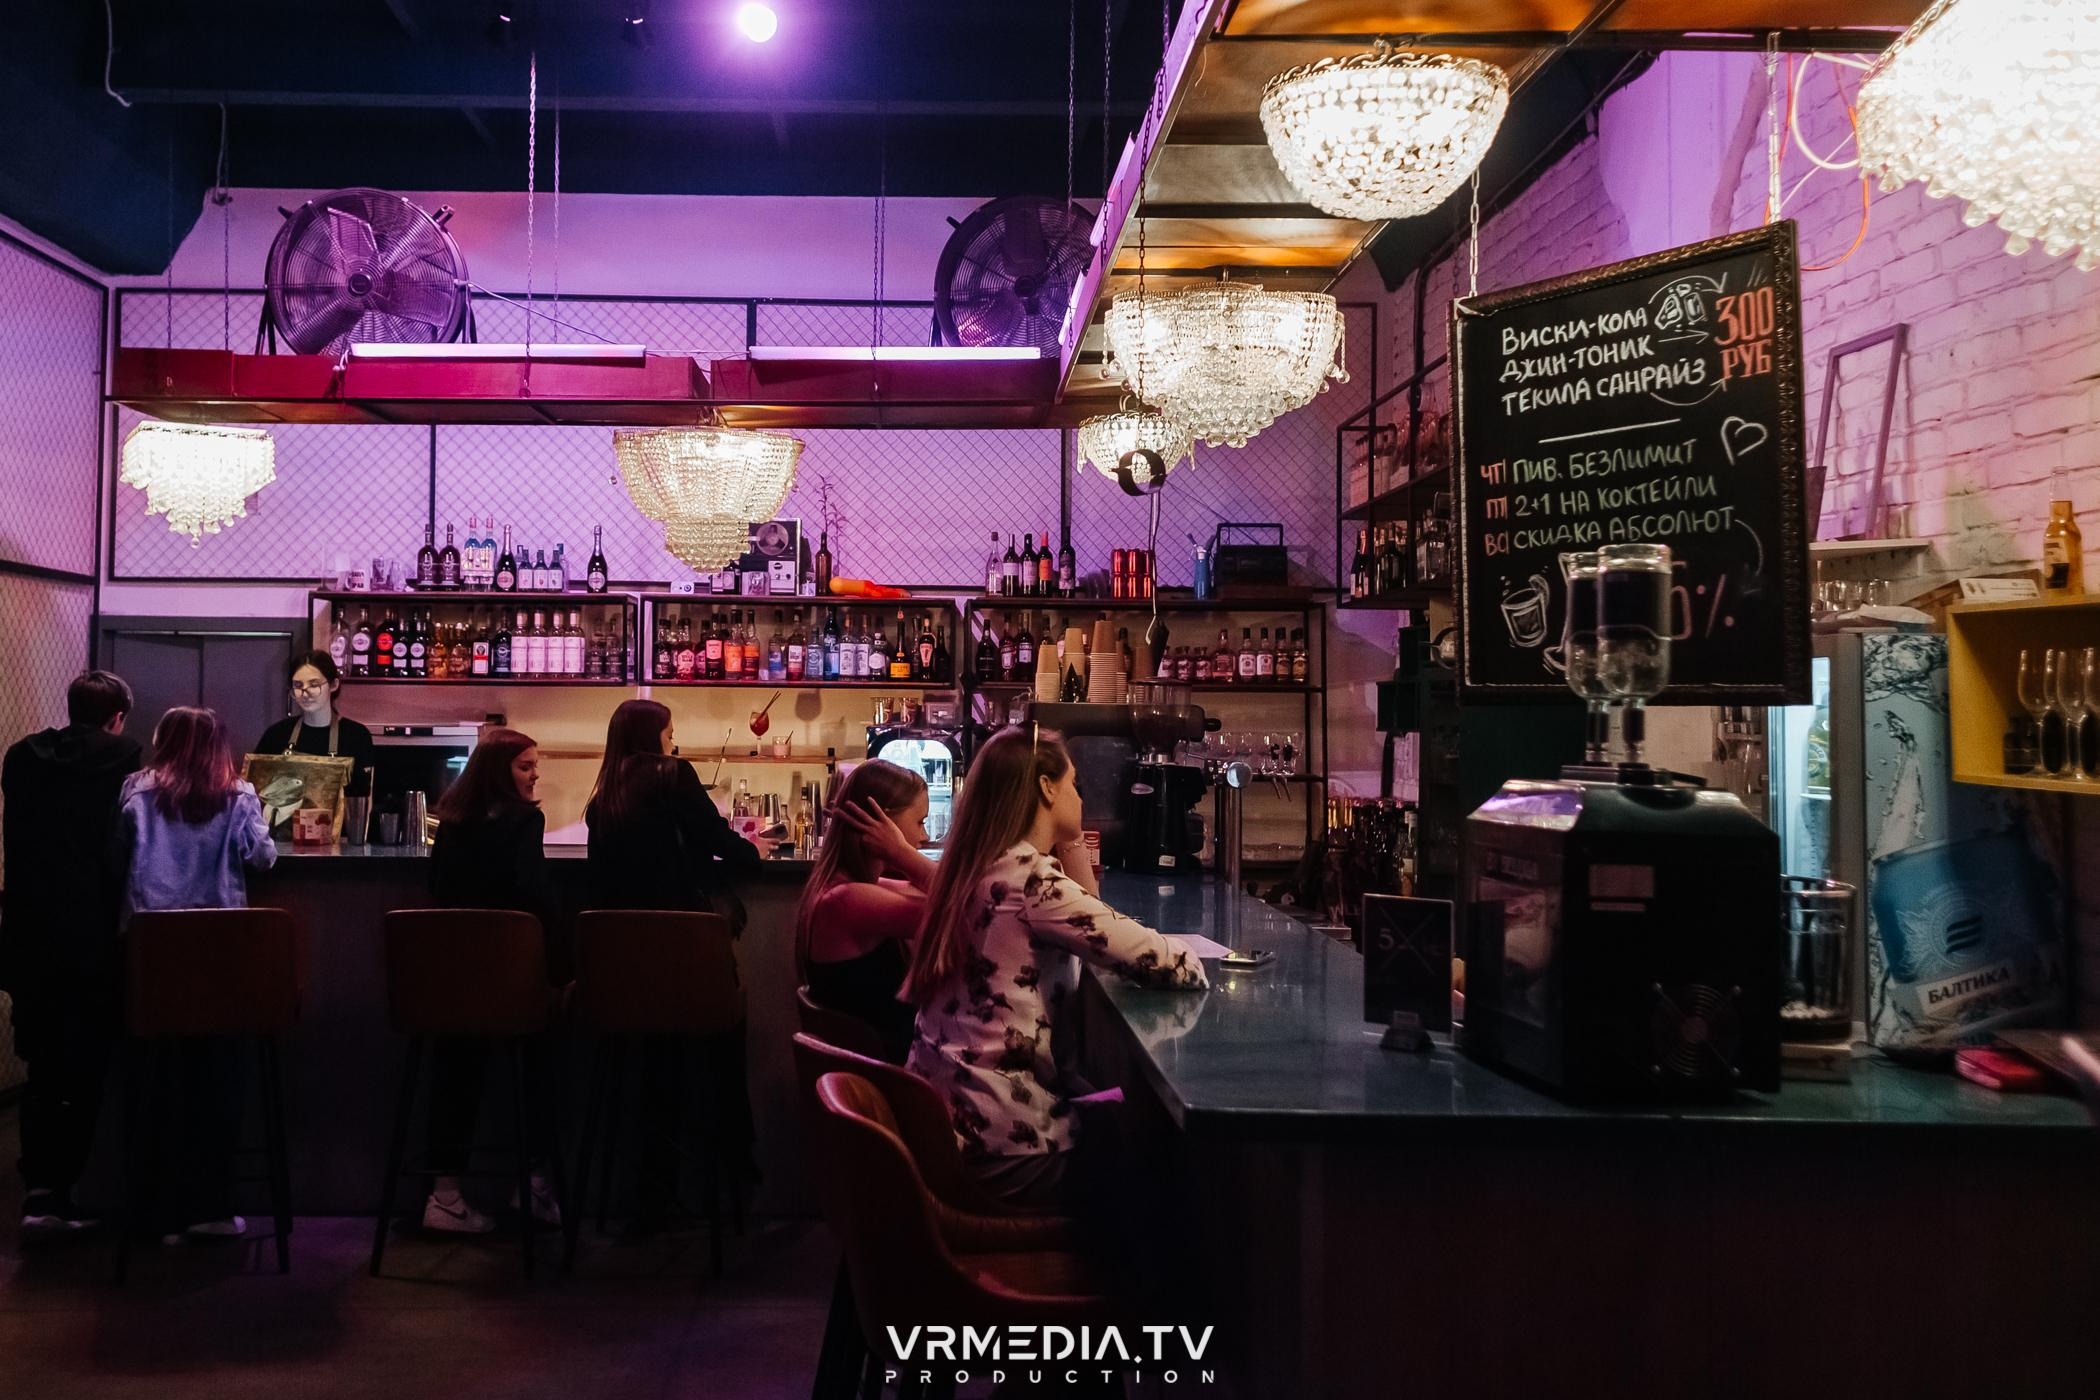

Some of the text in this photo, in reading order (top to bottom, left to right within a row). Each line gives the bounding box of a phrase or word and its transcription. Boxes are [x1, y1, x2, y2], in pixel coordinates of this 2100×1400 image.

[1714, 286, 1775, 346] 300
[1499, 334, 1655, 383] ДЖИН-ТОНИК
[1720, 338, 1773, 382] РУБ
[1501, 358, 1706, 416] ТЕКИЛА САНРАЙЗ
[1569, 438, 1697, 480] БЕЗЛИМИТ
[1514, 493, 1551, 517] 2+1
[1560, 491, 1590, 515] НА
[1598, 475, 1718, 511] КОКТЕЙЛИ
[1513, 524, 1601, 549] СКИДКА
[1609, 506, 1735, 543] АБСОЛЮТ
[1928, 966, 2011, 1004] БАЛТИКА
